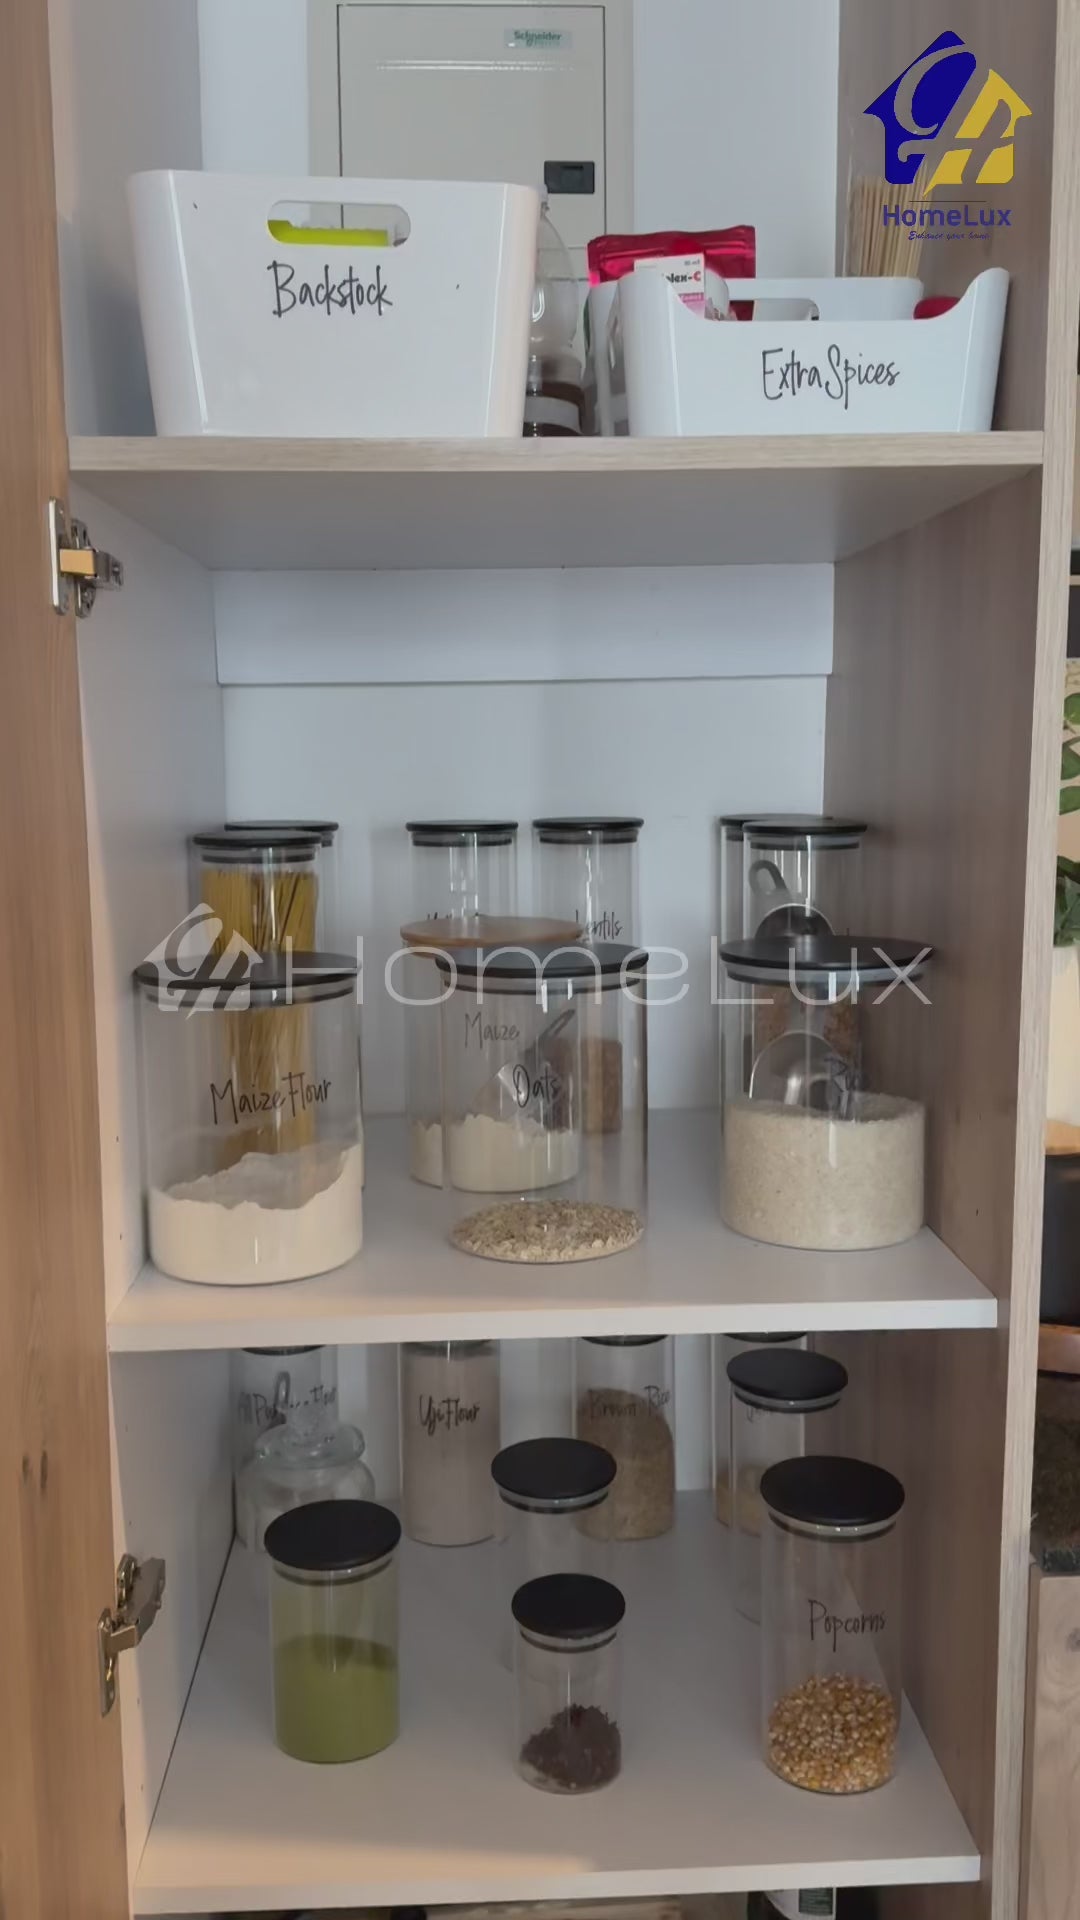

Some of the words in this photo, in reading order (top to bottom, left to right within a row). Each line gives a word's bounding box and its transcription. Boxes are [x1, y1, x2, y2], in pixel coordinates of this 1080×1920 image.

[267, 260, 393, 318] Backstock
[464, 1011, 520, 1049] Maize
[512, 1064, 561, 1108] Oats
[808, 1598, 887, 1653] Popcorns
